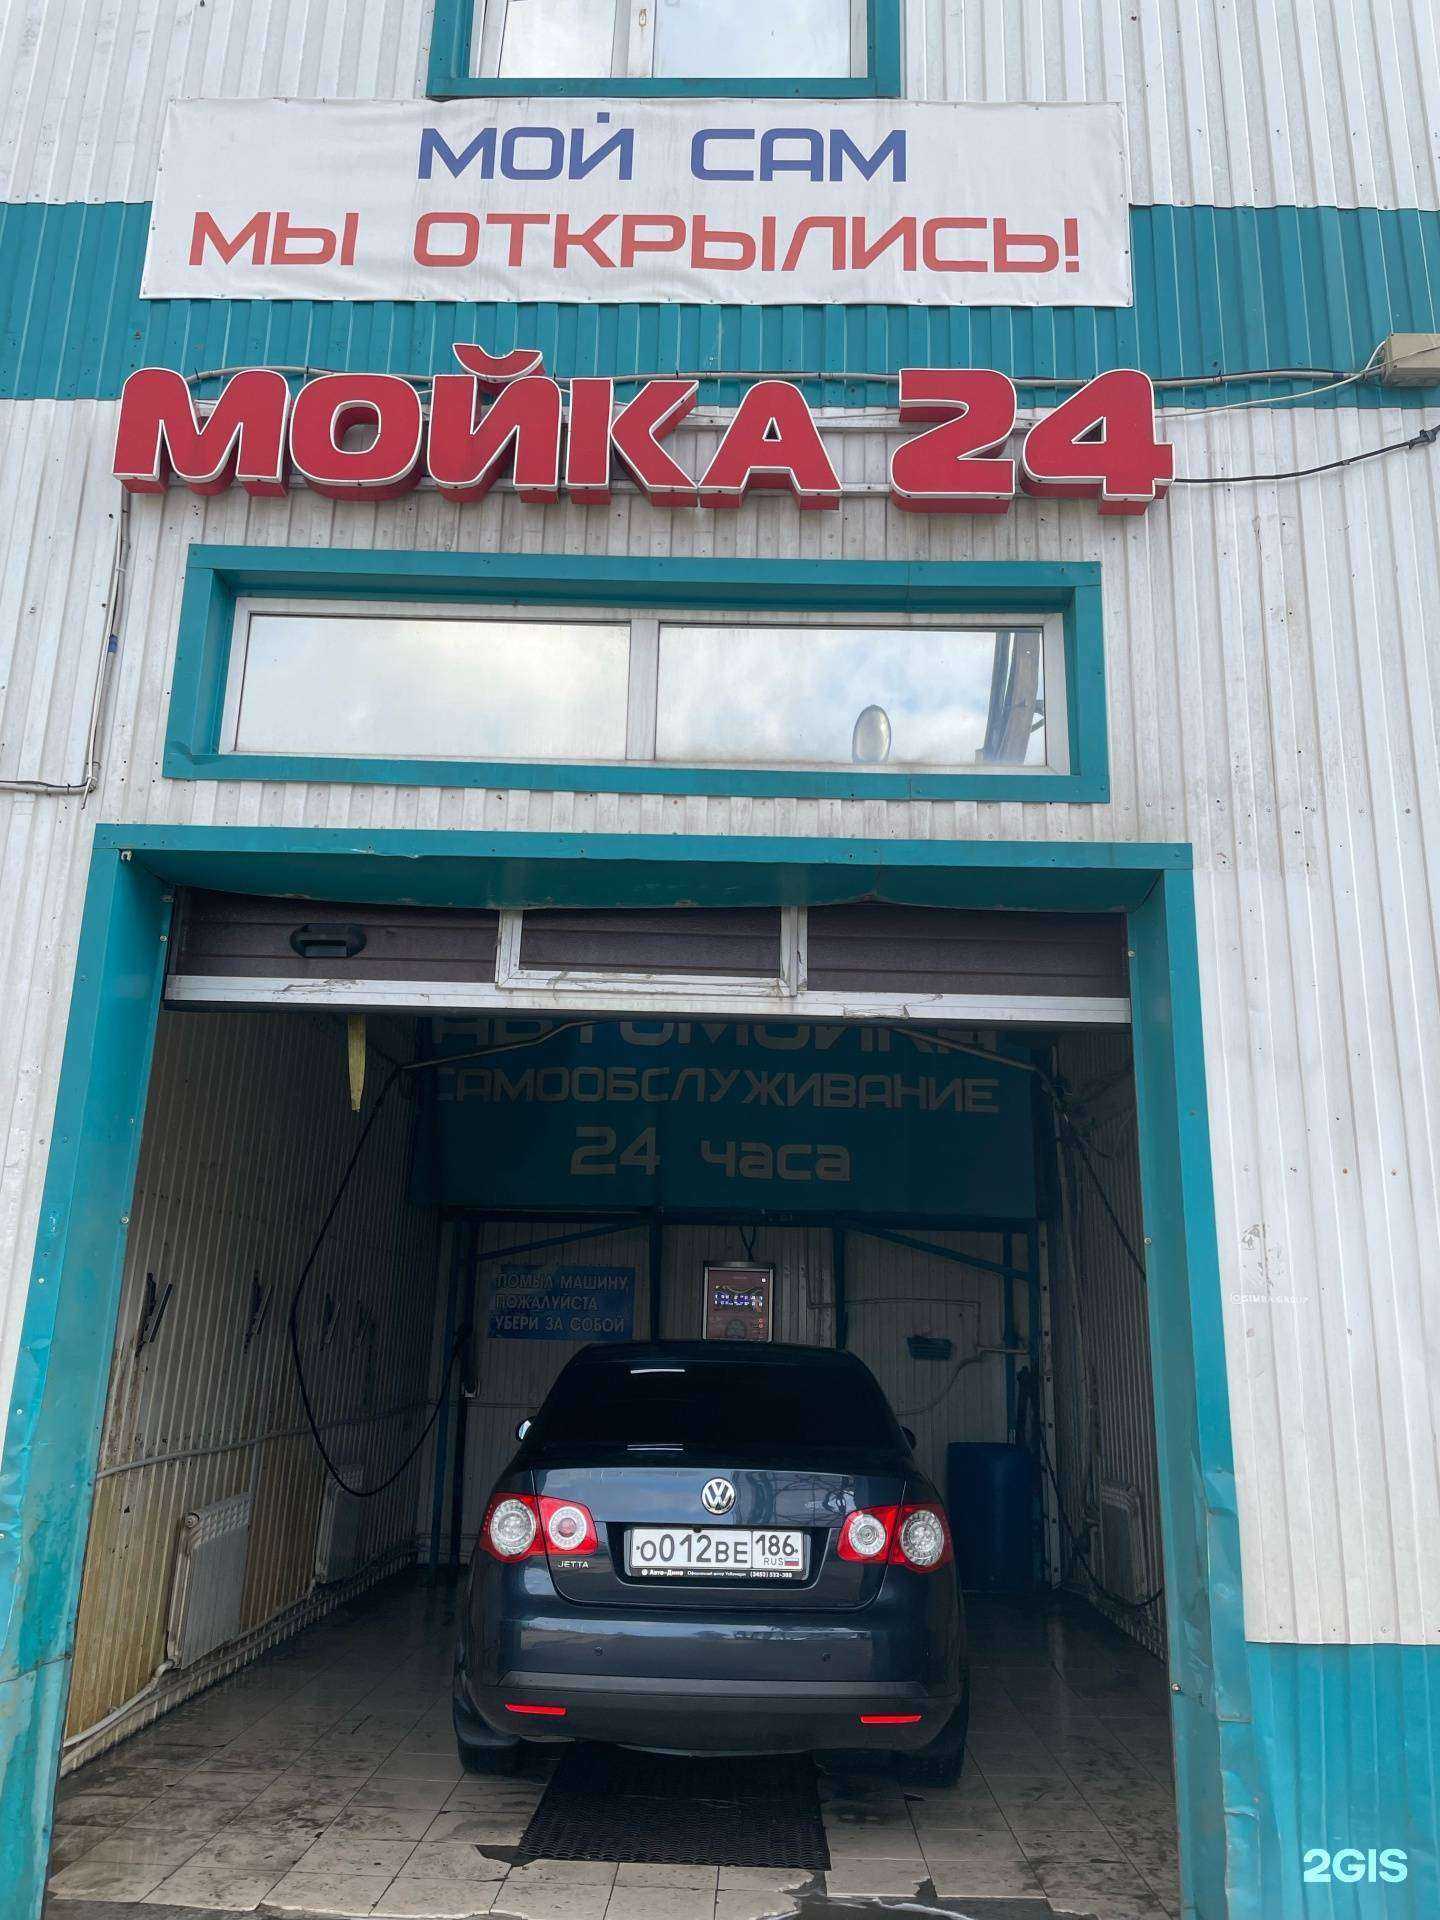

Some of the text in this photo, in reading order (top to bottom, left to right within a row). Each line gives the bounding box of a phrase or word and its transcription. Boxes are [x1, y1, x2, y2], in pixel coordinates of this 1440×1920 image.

[418, 111, 907, 183] МОЙ САМ
[189, 211, 1080, 273] МЫ ОТКРЫЛИСЬ!
[112, 342, 1175, 516] МОЙКА 24
[570, 1125, 852, 1181] 24 часа
[495, 1313, 625, 1333] УБЕРИ ЗА СОБОЙ
[754, 1533, 796, 1556] 186
[763, 1557, 784, 1567] RUS
[557, 1560, 590, 1570] JETTA
